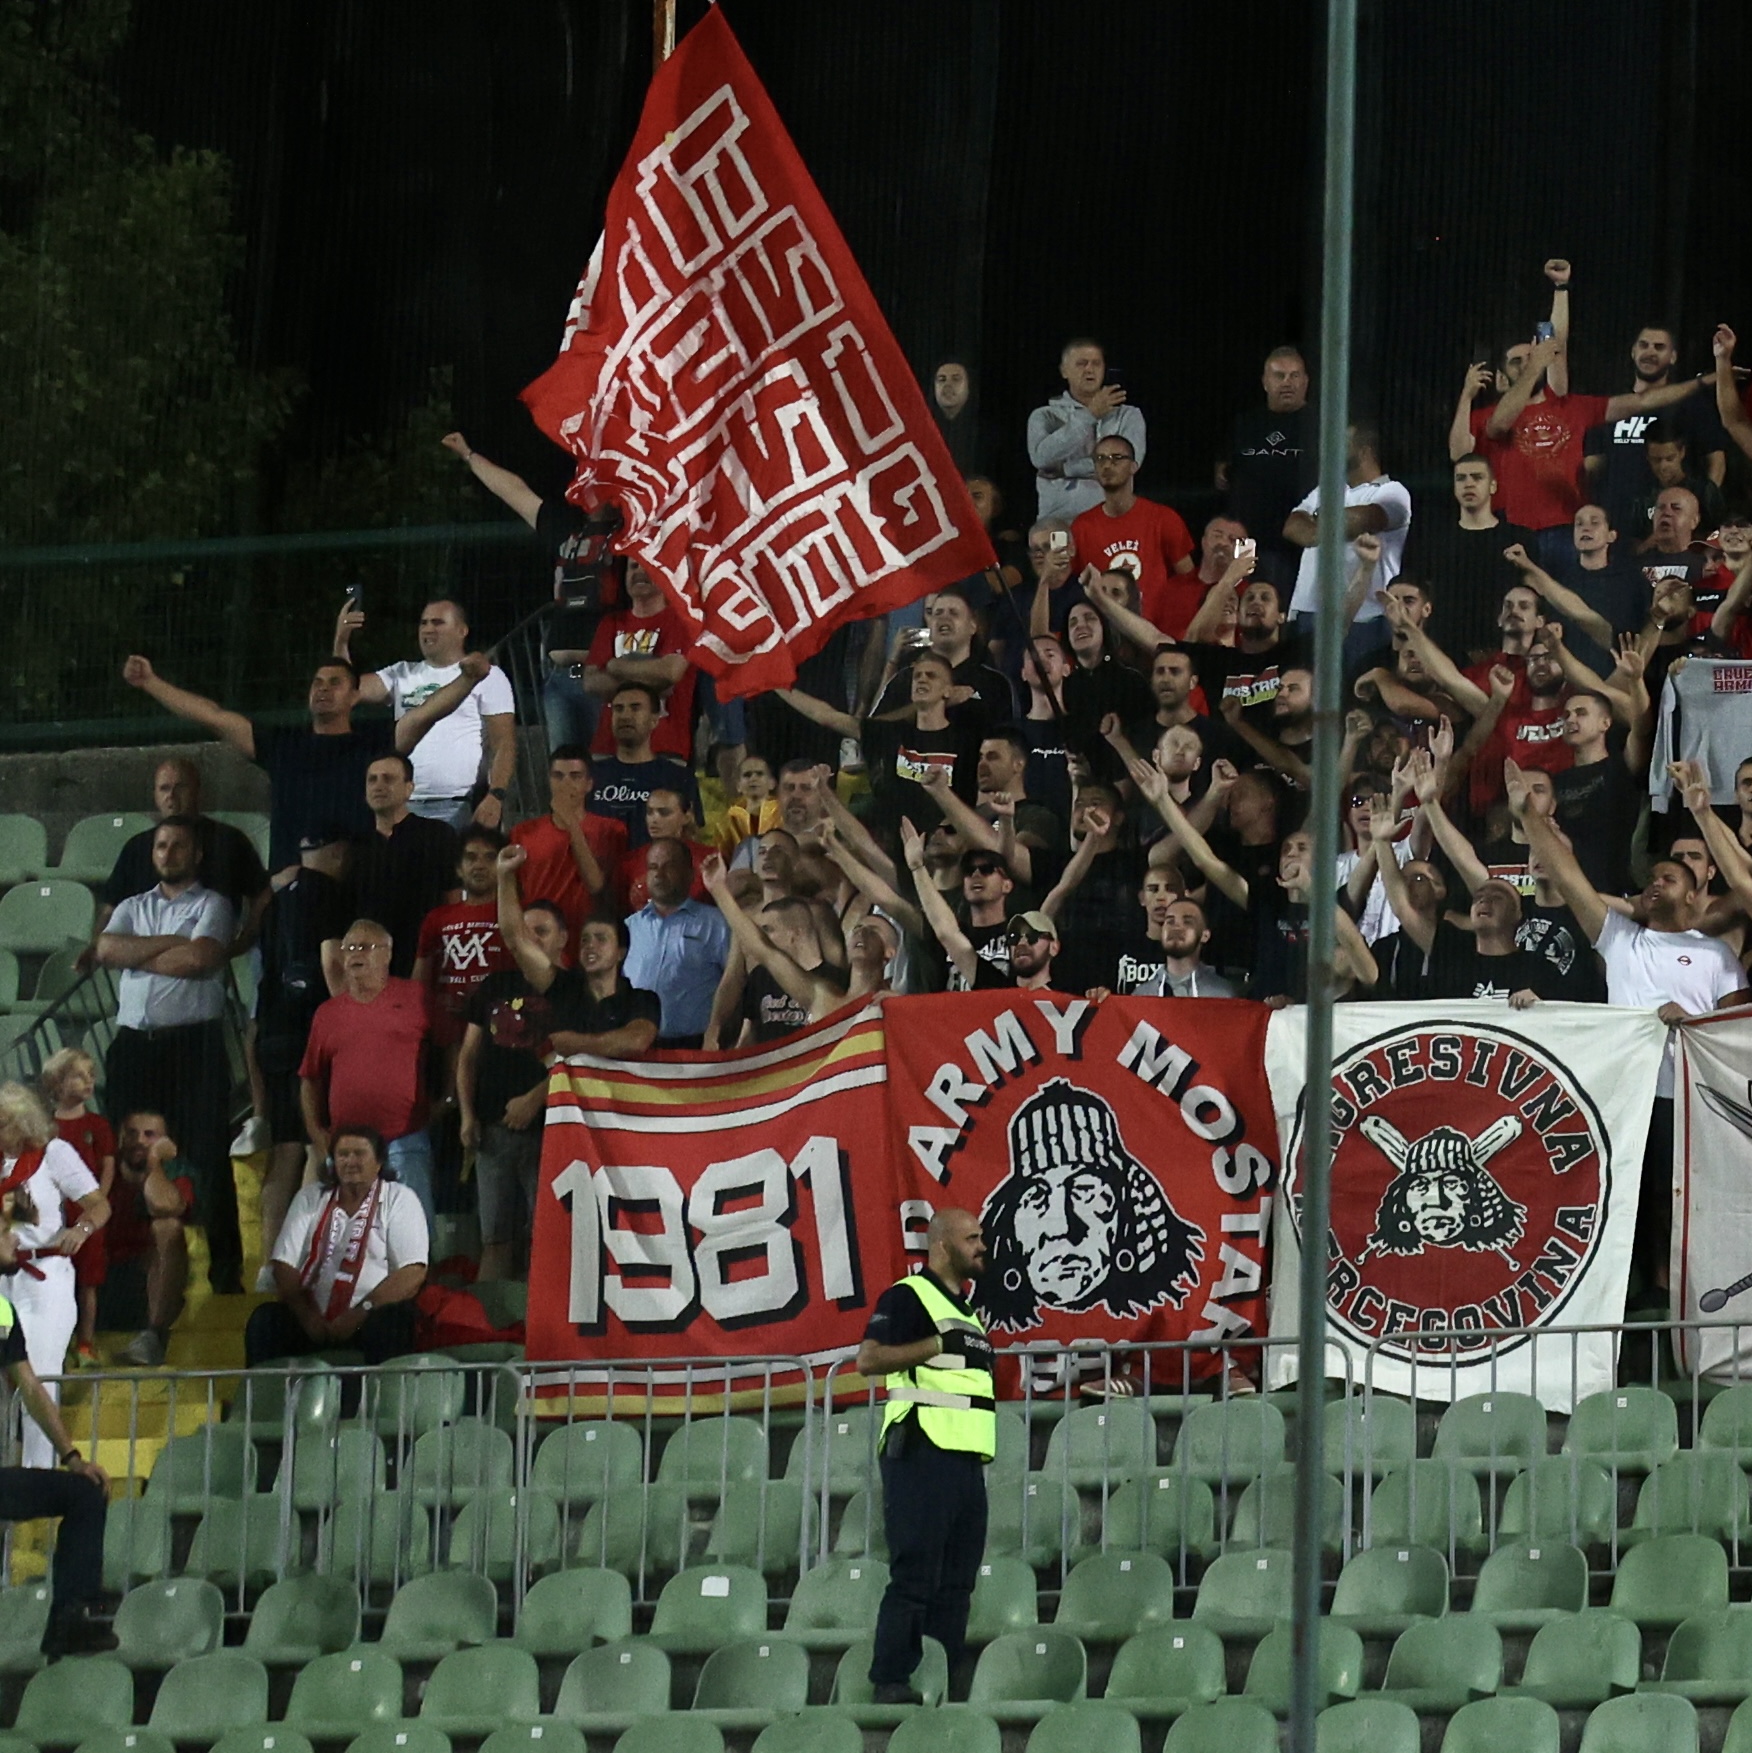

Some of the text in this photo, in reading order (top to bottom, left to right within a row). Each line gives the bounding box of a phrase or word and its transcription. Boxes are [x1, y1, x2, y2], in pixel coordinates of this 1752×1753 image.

[1103, 539, 1140, 557] VELEŽ
[594, 785, 650, 803] s.Olive
[908, 998, 1095, 1185] ARMY
[1331, 1031, 1595, 1174] GRESIVNA
[551, 1134, 860, 1332] 1981
[1328, 1202, 1596, 1354] RCEGOVINA
